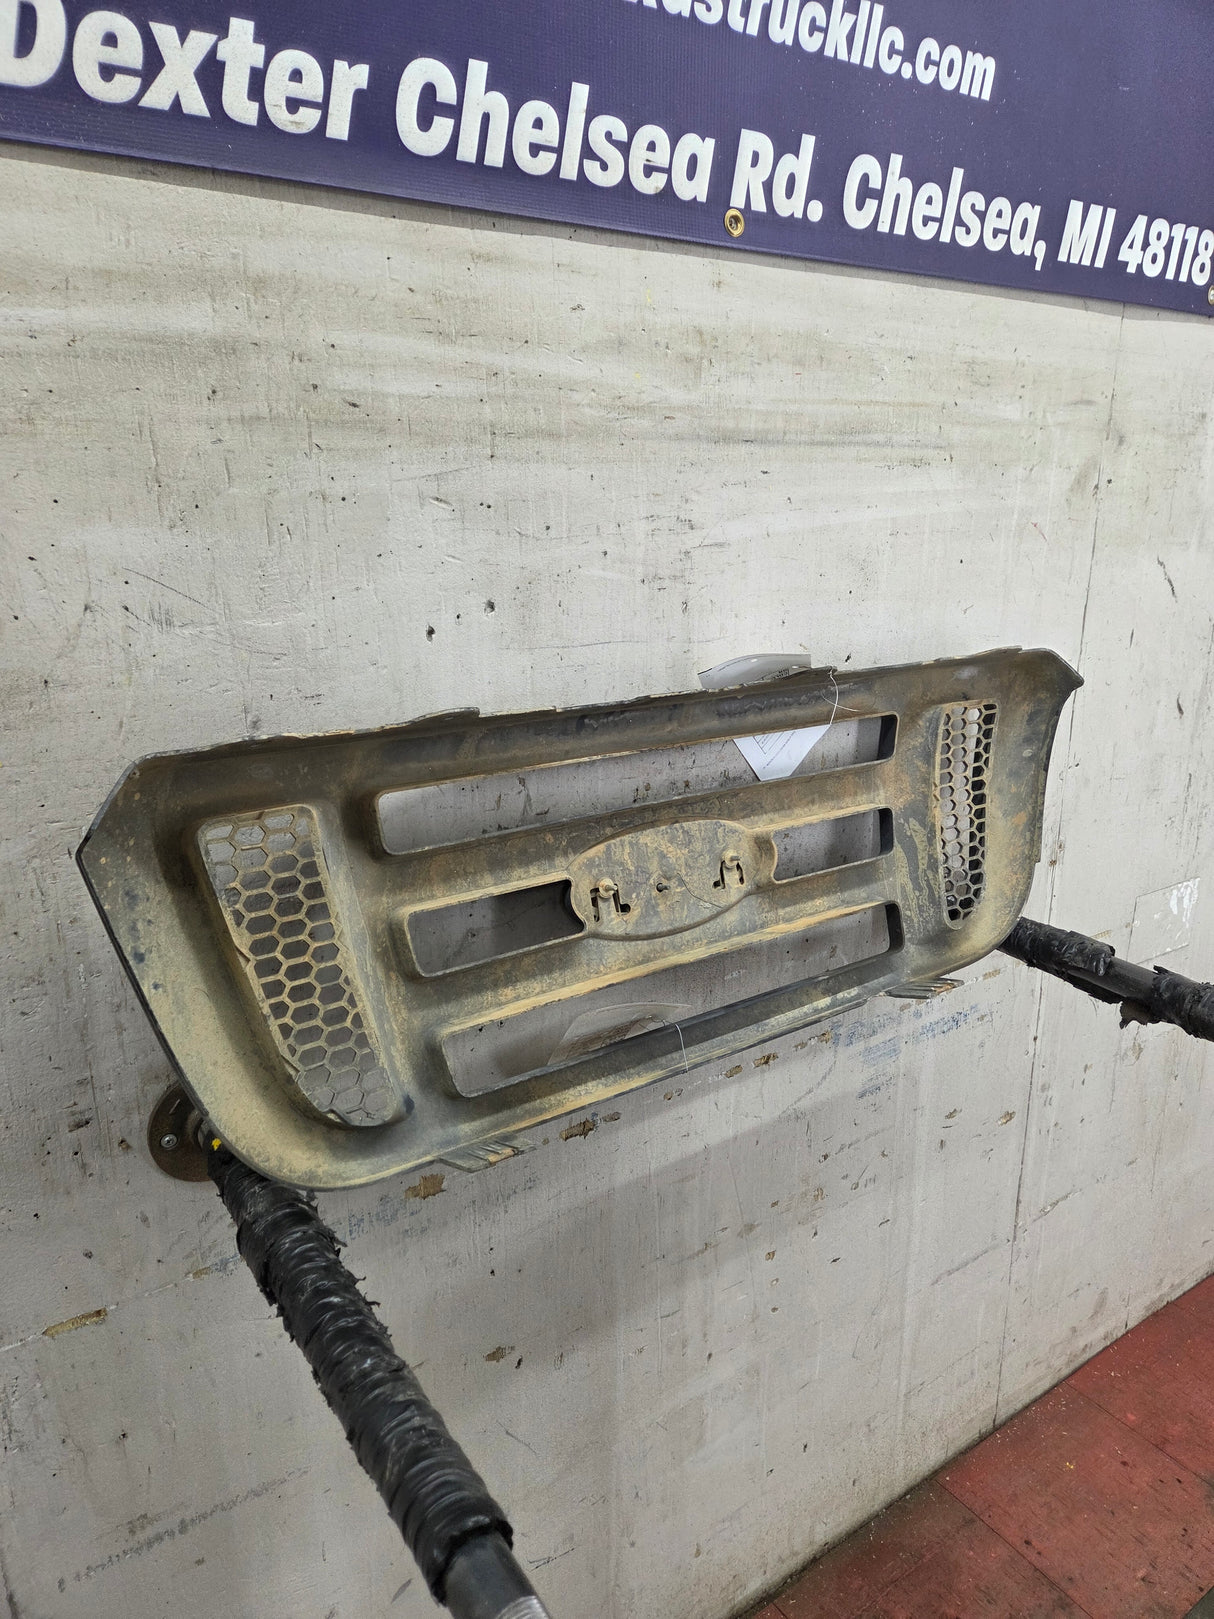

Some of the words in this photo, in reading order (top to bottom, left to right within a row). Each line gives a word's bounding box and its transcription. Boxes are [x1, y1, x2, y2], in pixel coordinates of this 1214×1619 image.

[0, 0, 370, 141] Dexter
[396, 57, 716, 203] Chelsea
[730, 128, 824, 223] Rd.
[843, 153, 1047, 272] Chelsea,
[1057, 199, 1117, 269] MI
[1117, 214, 1214, 287] 48118
